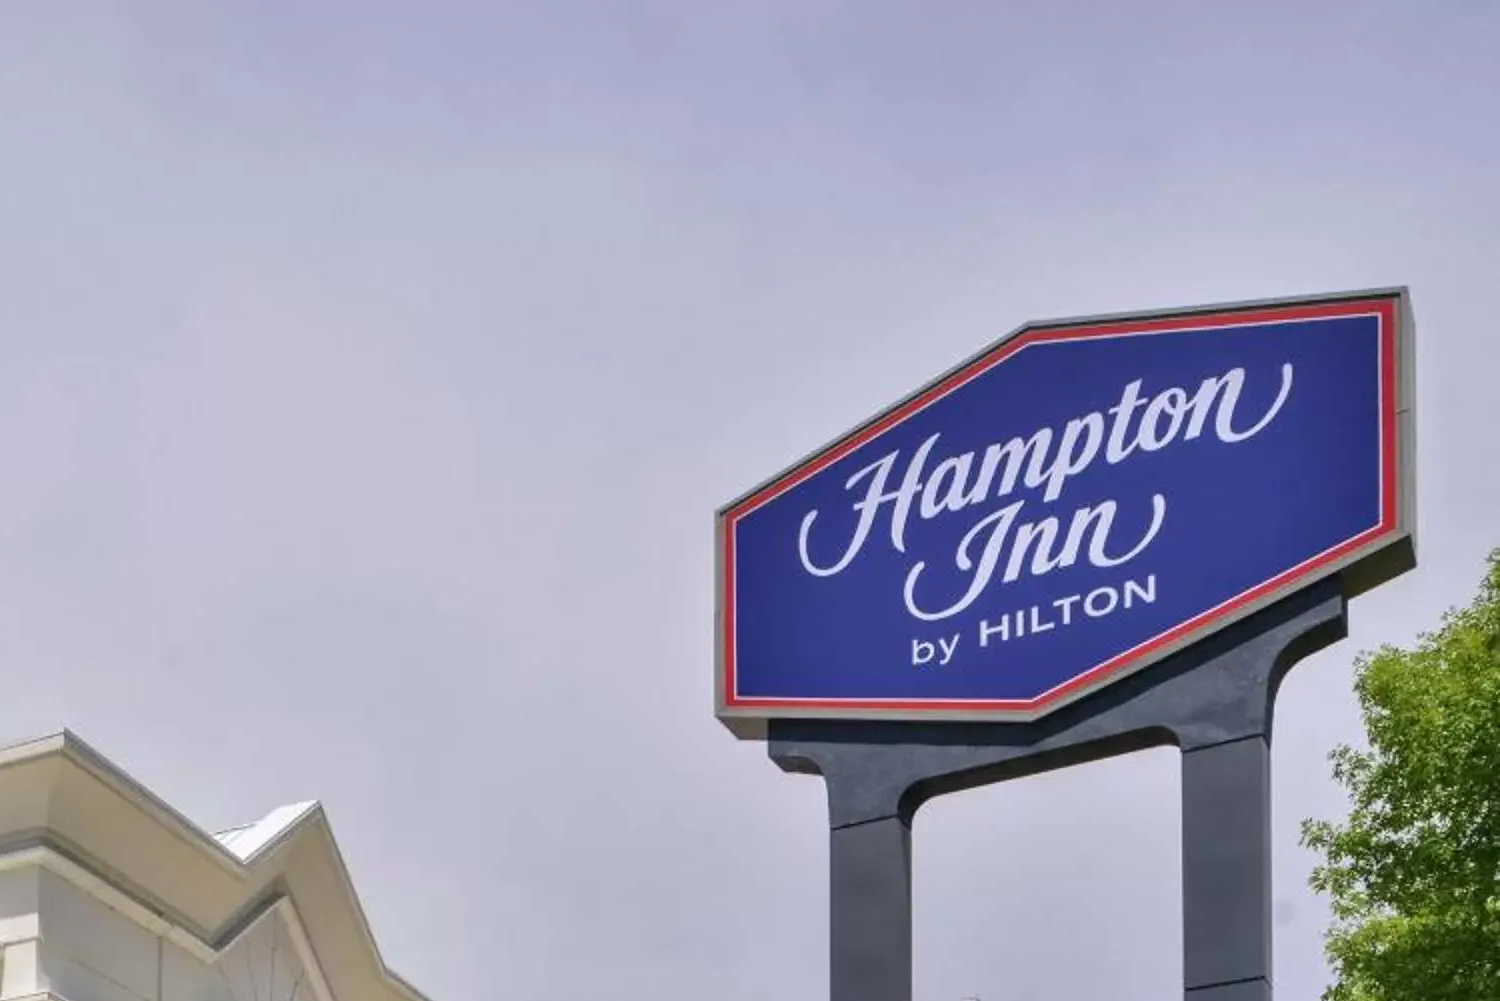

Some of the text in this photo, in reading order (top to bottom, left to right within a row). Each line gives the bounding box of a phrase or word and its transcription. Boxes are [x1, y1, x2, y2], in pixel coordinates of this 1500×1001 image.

[799, 362, 1293, 577] Hampton
[903, 494, 1166, 621] Inn
[912, 575, 1157, 666] by HILTON
